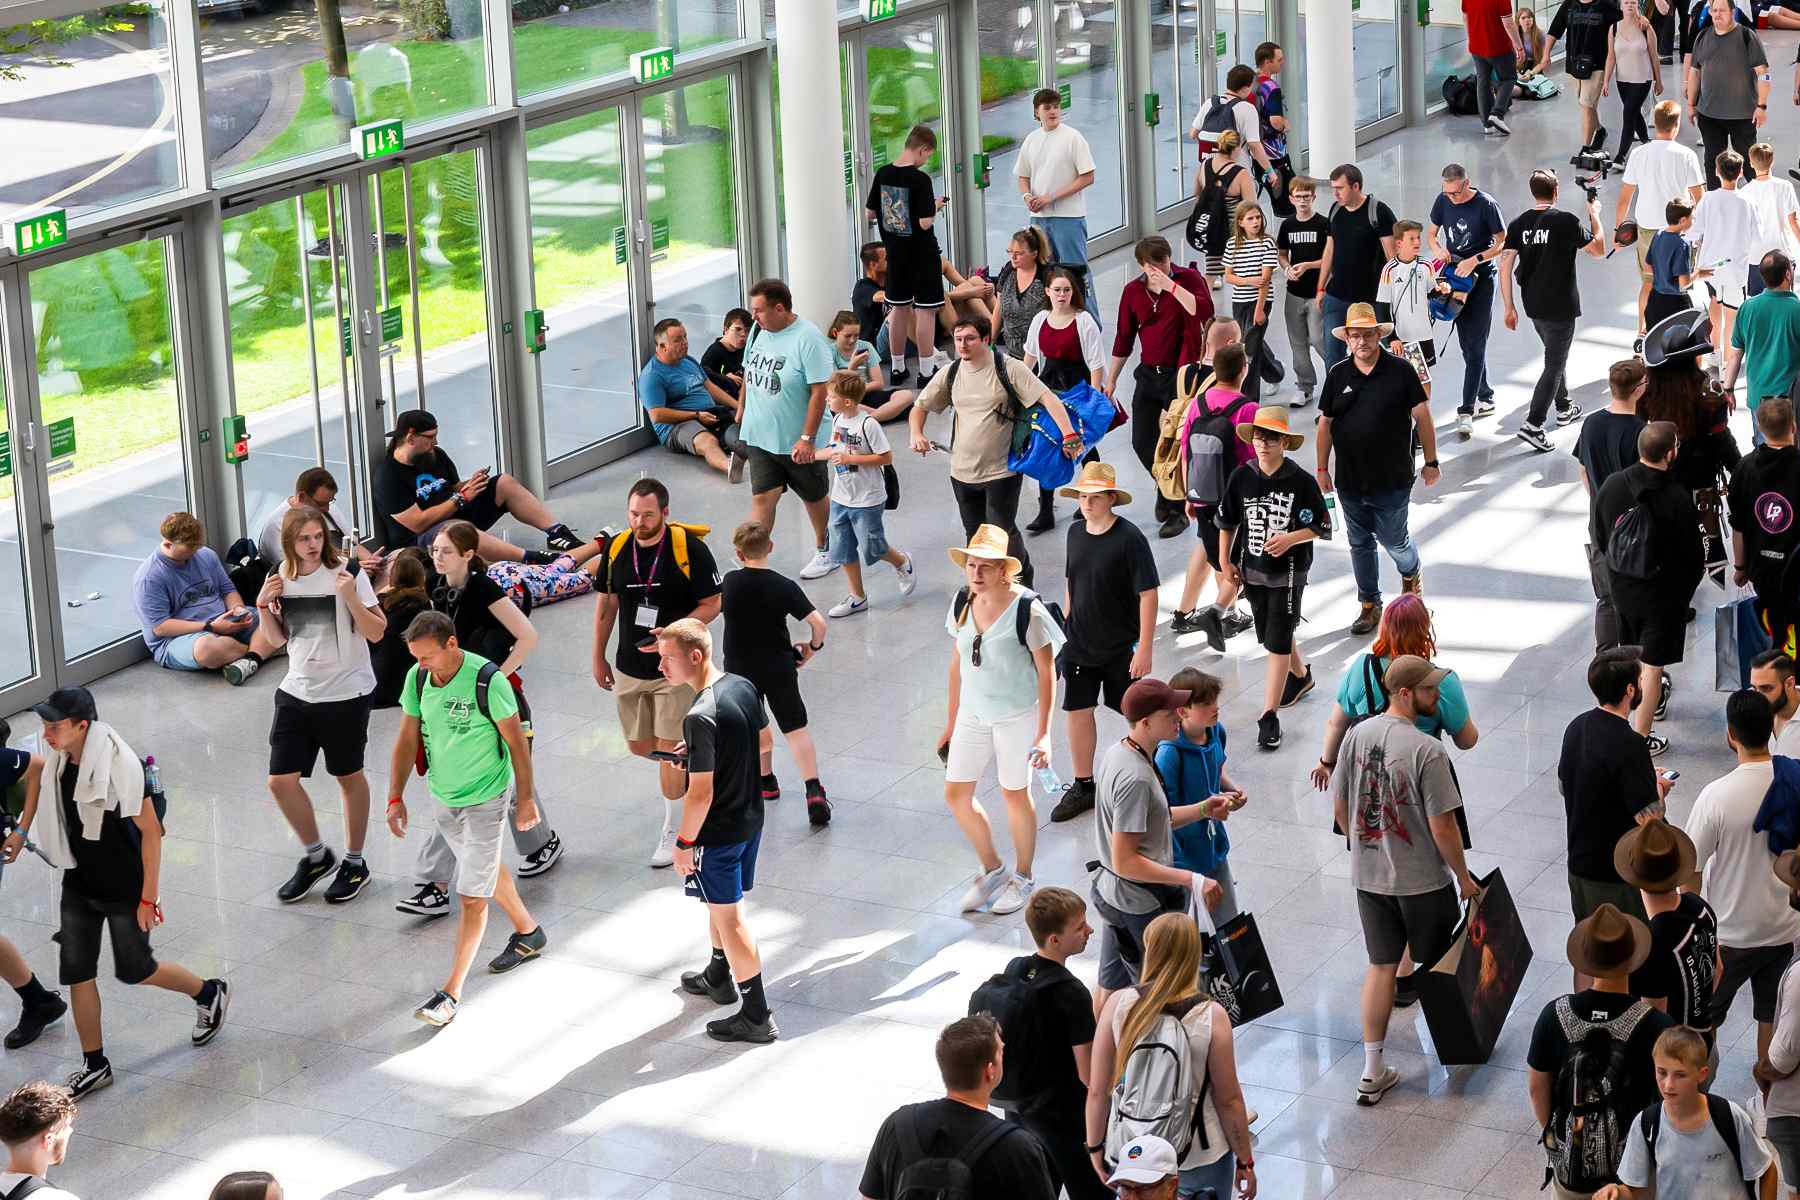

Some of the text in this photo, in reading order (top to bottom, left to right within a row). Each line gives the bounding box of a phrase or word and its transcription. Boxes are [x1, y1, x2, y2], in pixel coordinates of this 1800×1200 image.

[1288, 231, 1318, 244] PUMA
[1522, 229, 1550, 245] CEW
[747, 353, 786, 373] AMP
[746, 370, 781, 391] AVID
